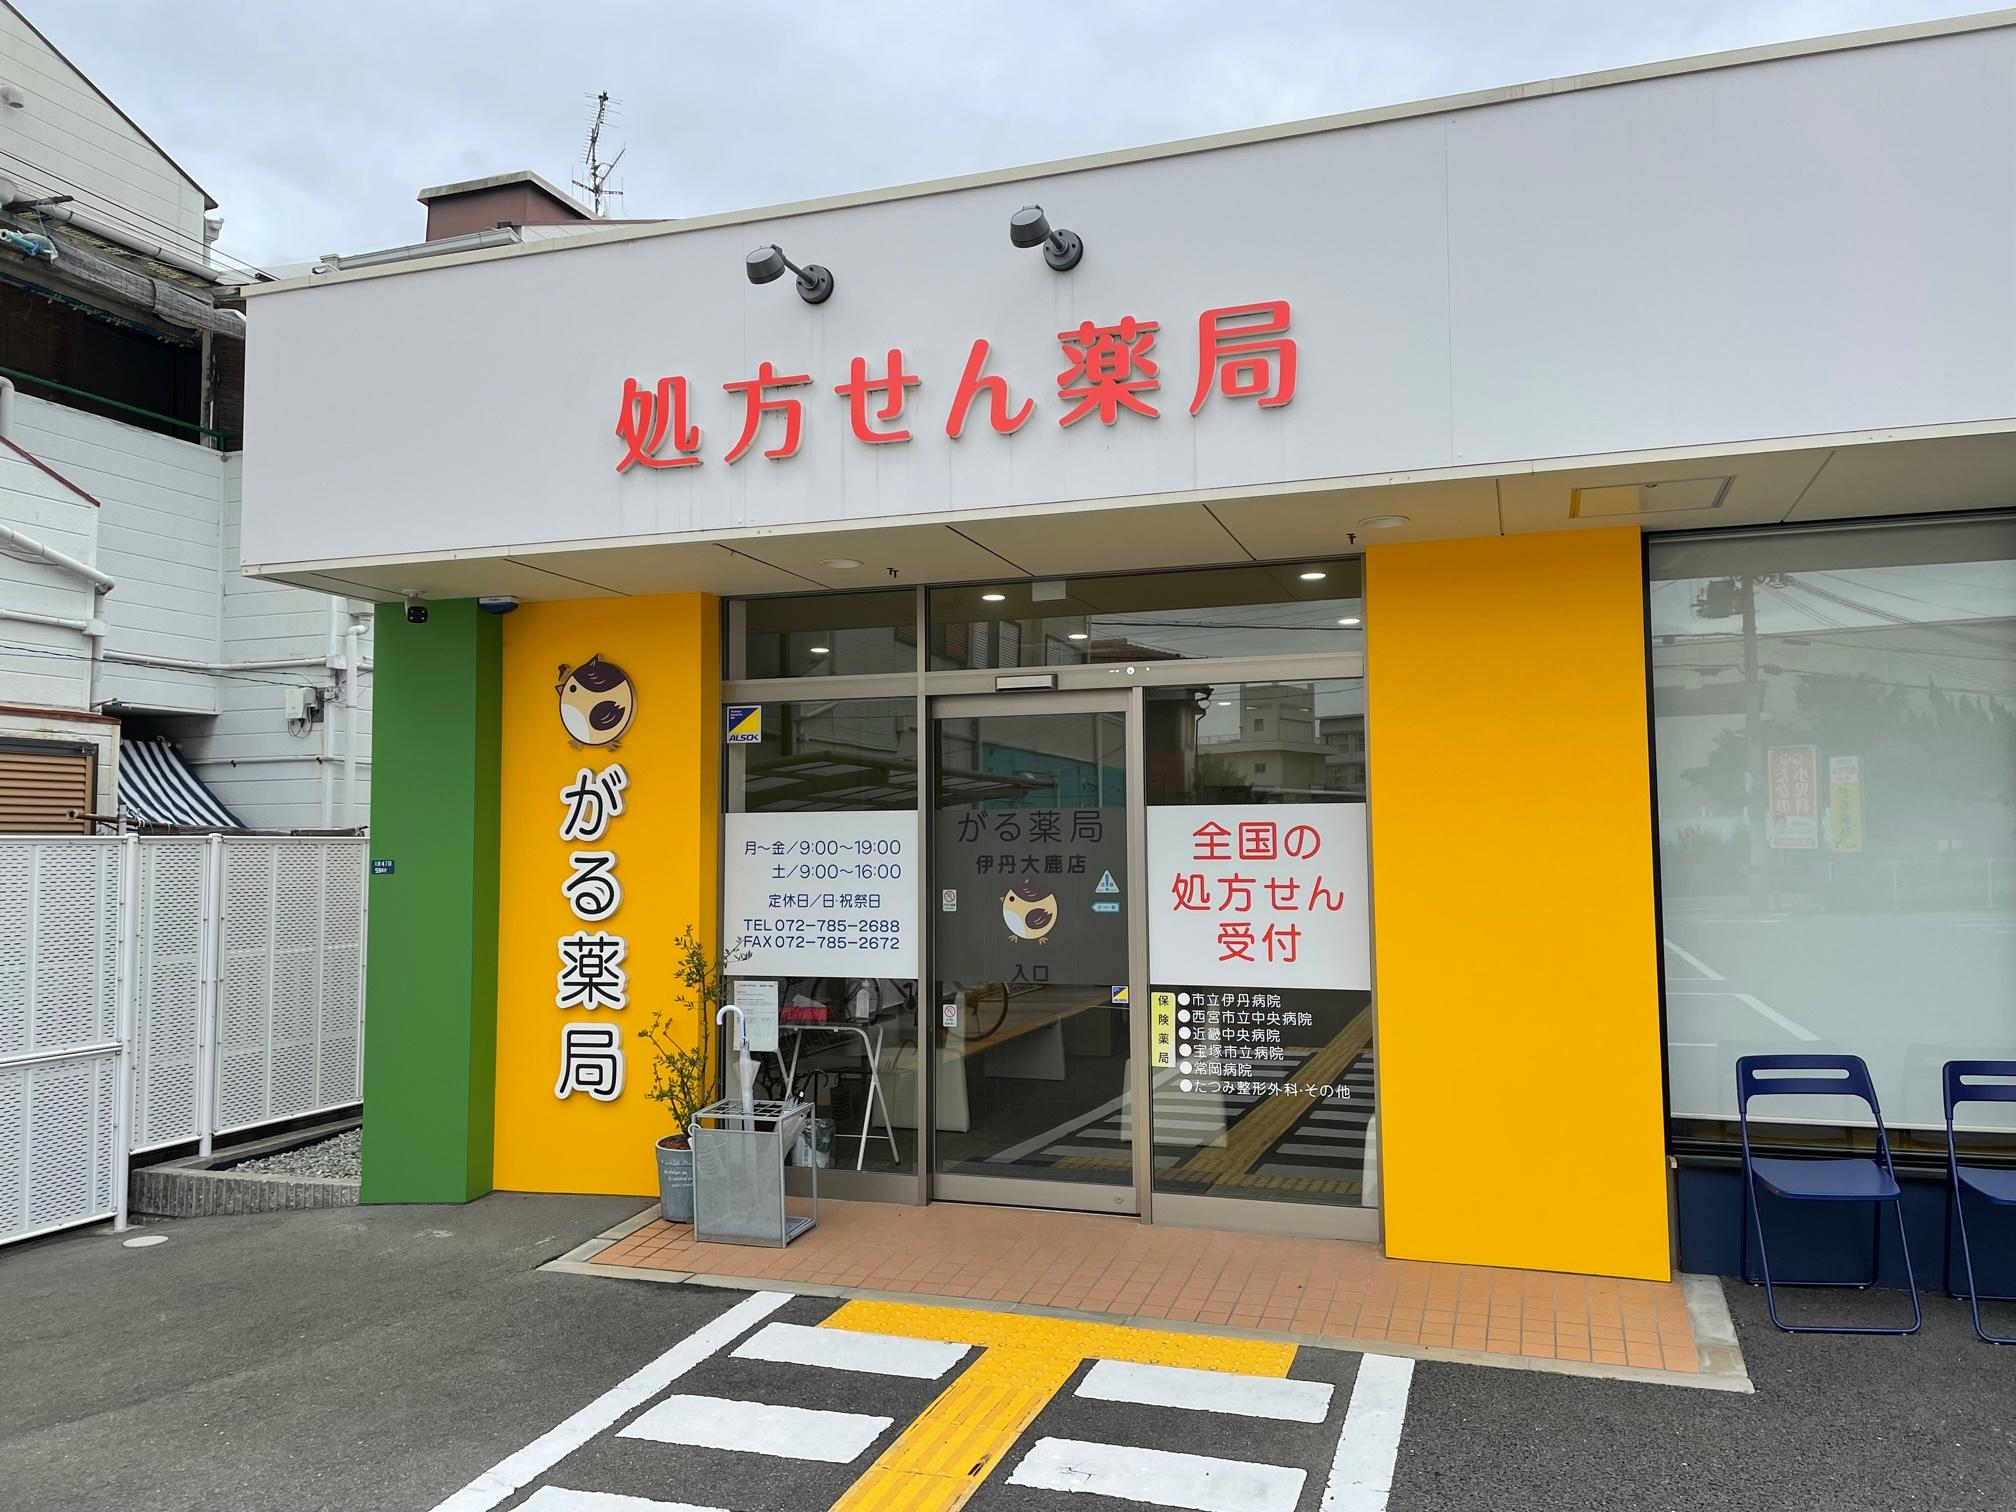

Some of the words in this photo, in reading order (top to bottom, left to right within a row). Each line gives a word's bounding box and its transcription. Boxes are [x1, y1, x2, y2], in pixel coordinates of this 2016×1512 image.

[616, 300, 1297, 473] 処方せん薬局
[729, 734, 759, 742] ALSOK
[958, 809, 1103, 843] がる薬局
[1192, 820, 1322, 860] 全国の
[976, 854, 1087, 874] 伊丹大鹿店
[1171, 872, 1345, 912] 処方せん
[558, 768, 623, 1097] がる薬局
[743, 918, 772, 932] TEL
[775, 919, 900, 933] 072-785-2688
[743, 935, 772, 948] FAX
[775, 935, 900, 950] 072-785-2672
[1217, 922, 1302, 963] 受付
[1011, 963, 1049, 982] 入口
[1191, 992, 1281, 1008] 市立伊丹病院
[1192, 1009, 1313, 1027] 西宮市立中央病院
[1158, 994, 1170, 1064] 保険薬局
[1192, 1026, 1281, 1043] 近畿中央病院
[1193, 1043, 1285, 1061] 宝塚市立病院
[1193, 1062, 1253, 1077] 常岡病院
